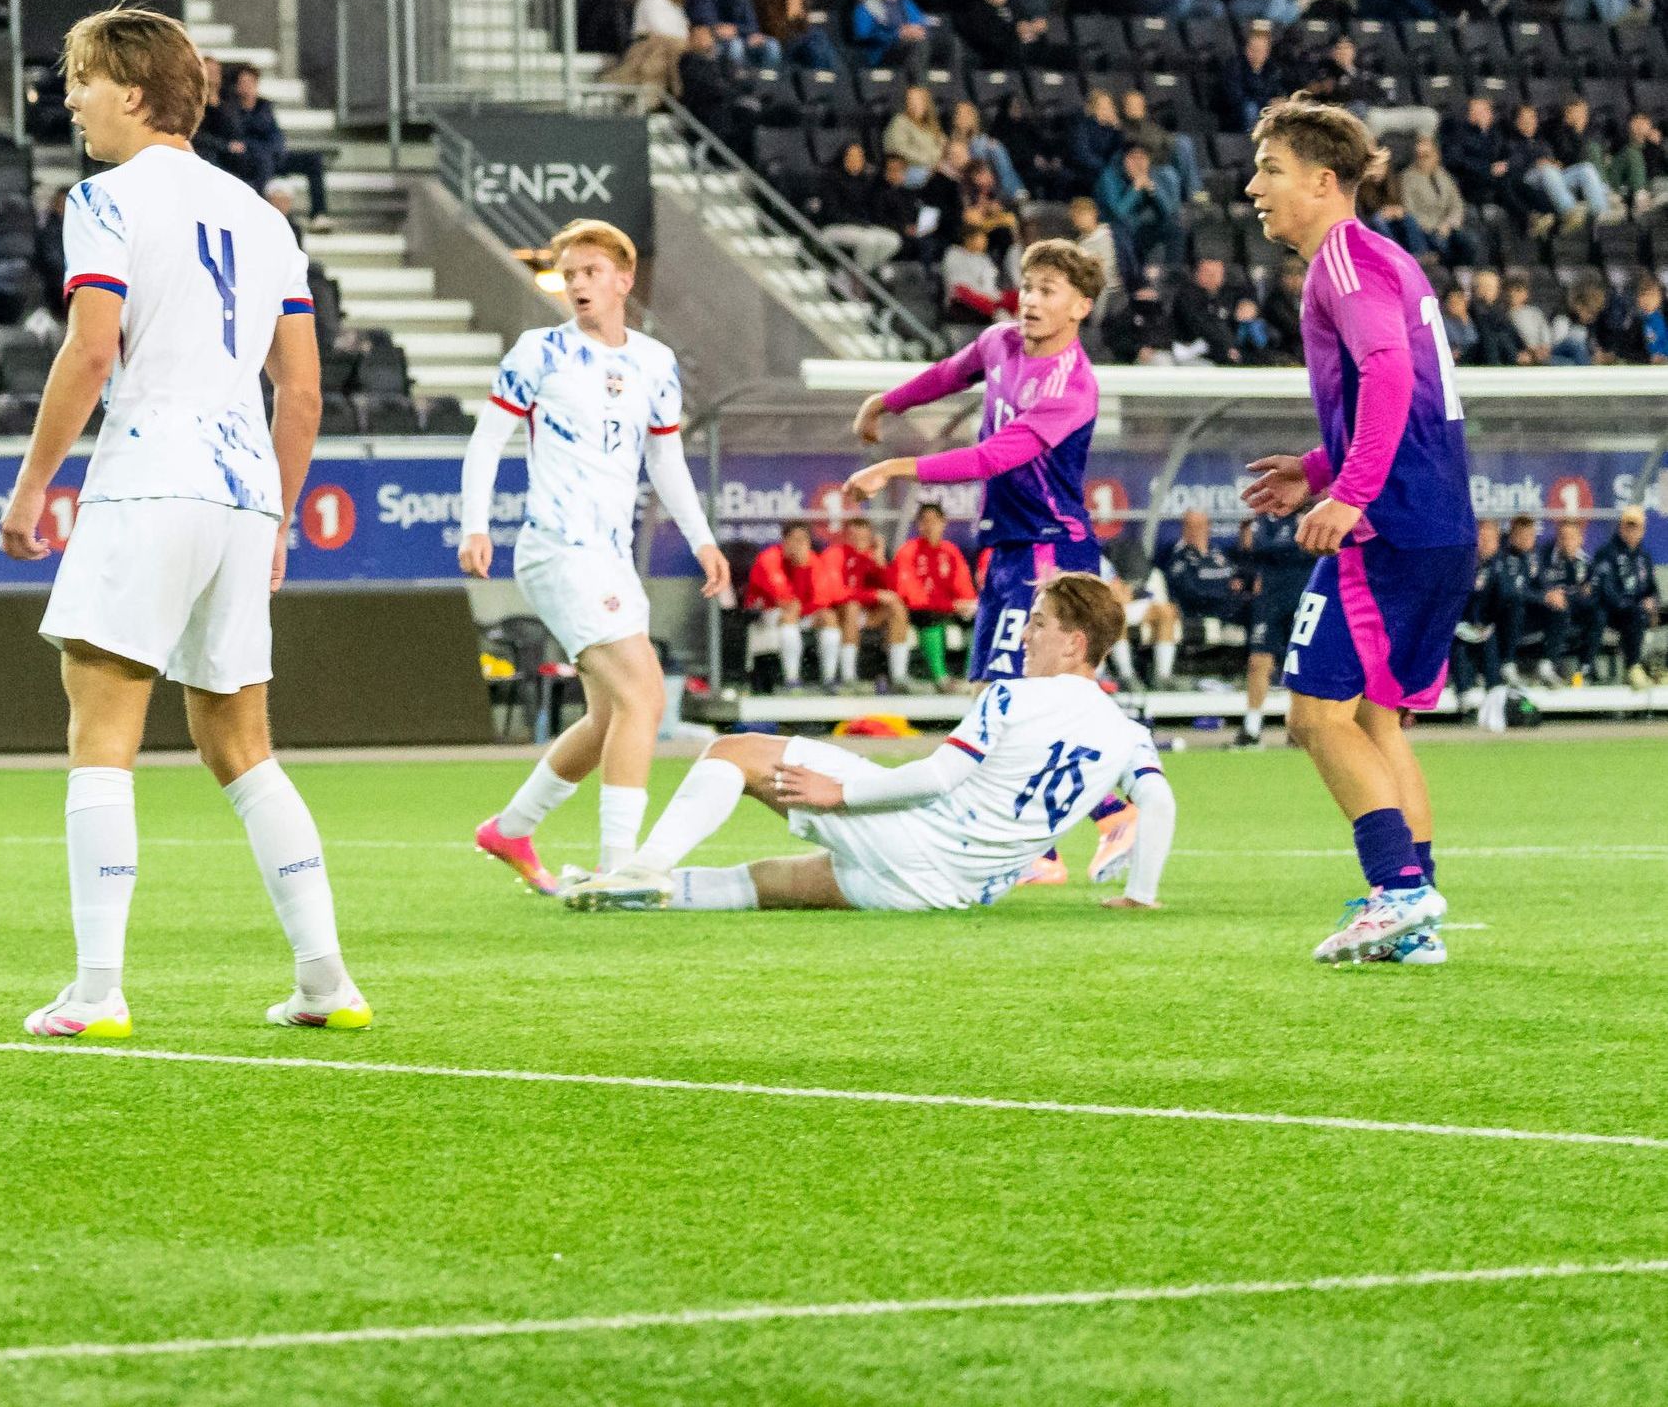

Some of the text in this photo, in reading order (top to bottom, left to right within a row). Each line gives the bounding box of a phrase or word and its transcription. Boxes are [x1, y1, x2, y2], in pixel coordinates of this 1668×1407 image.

[473, 162, 614, 204] ENRX
[196, 221, 237, 359] 4
[315, 493, 340, 539] 1
